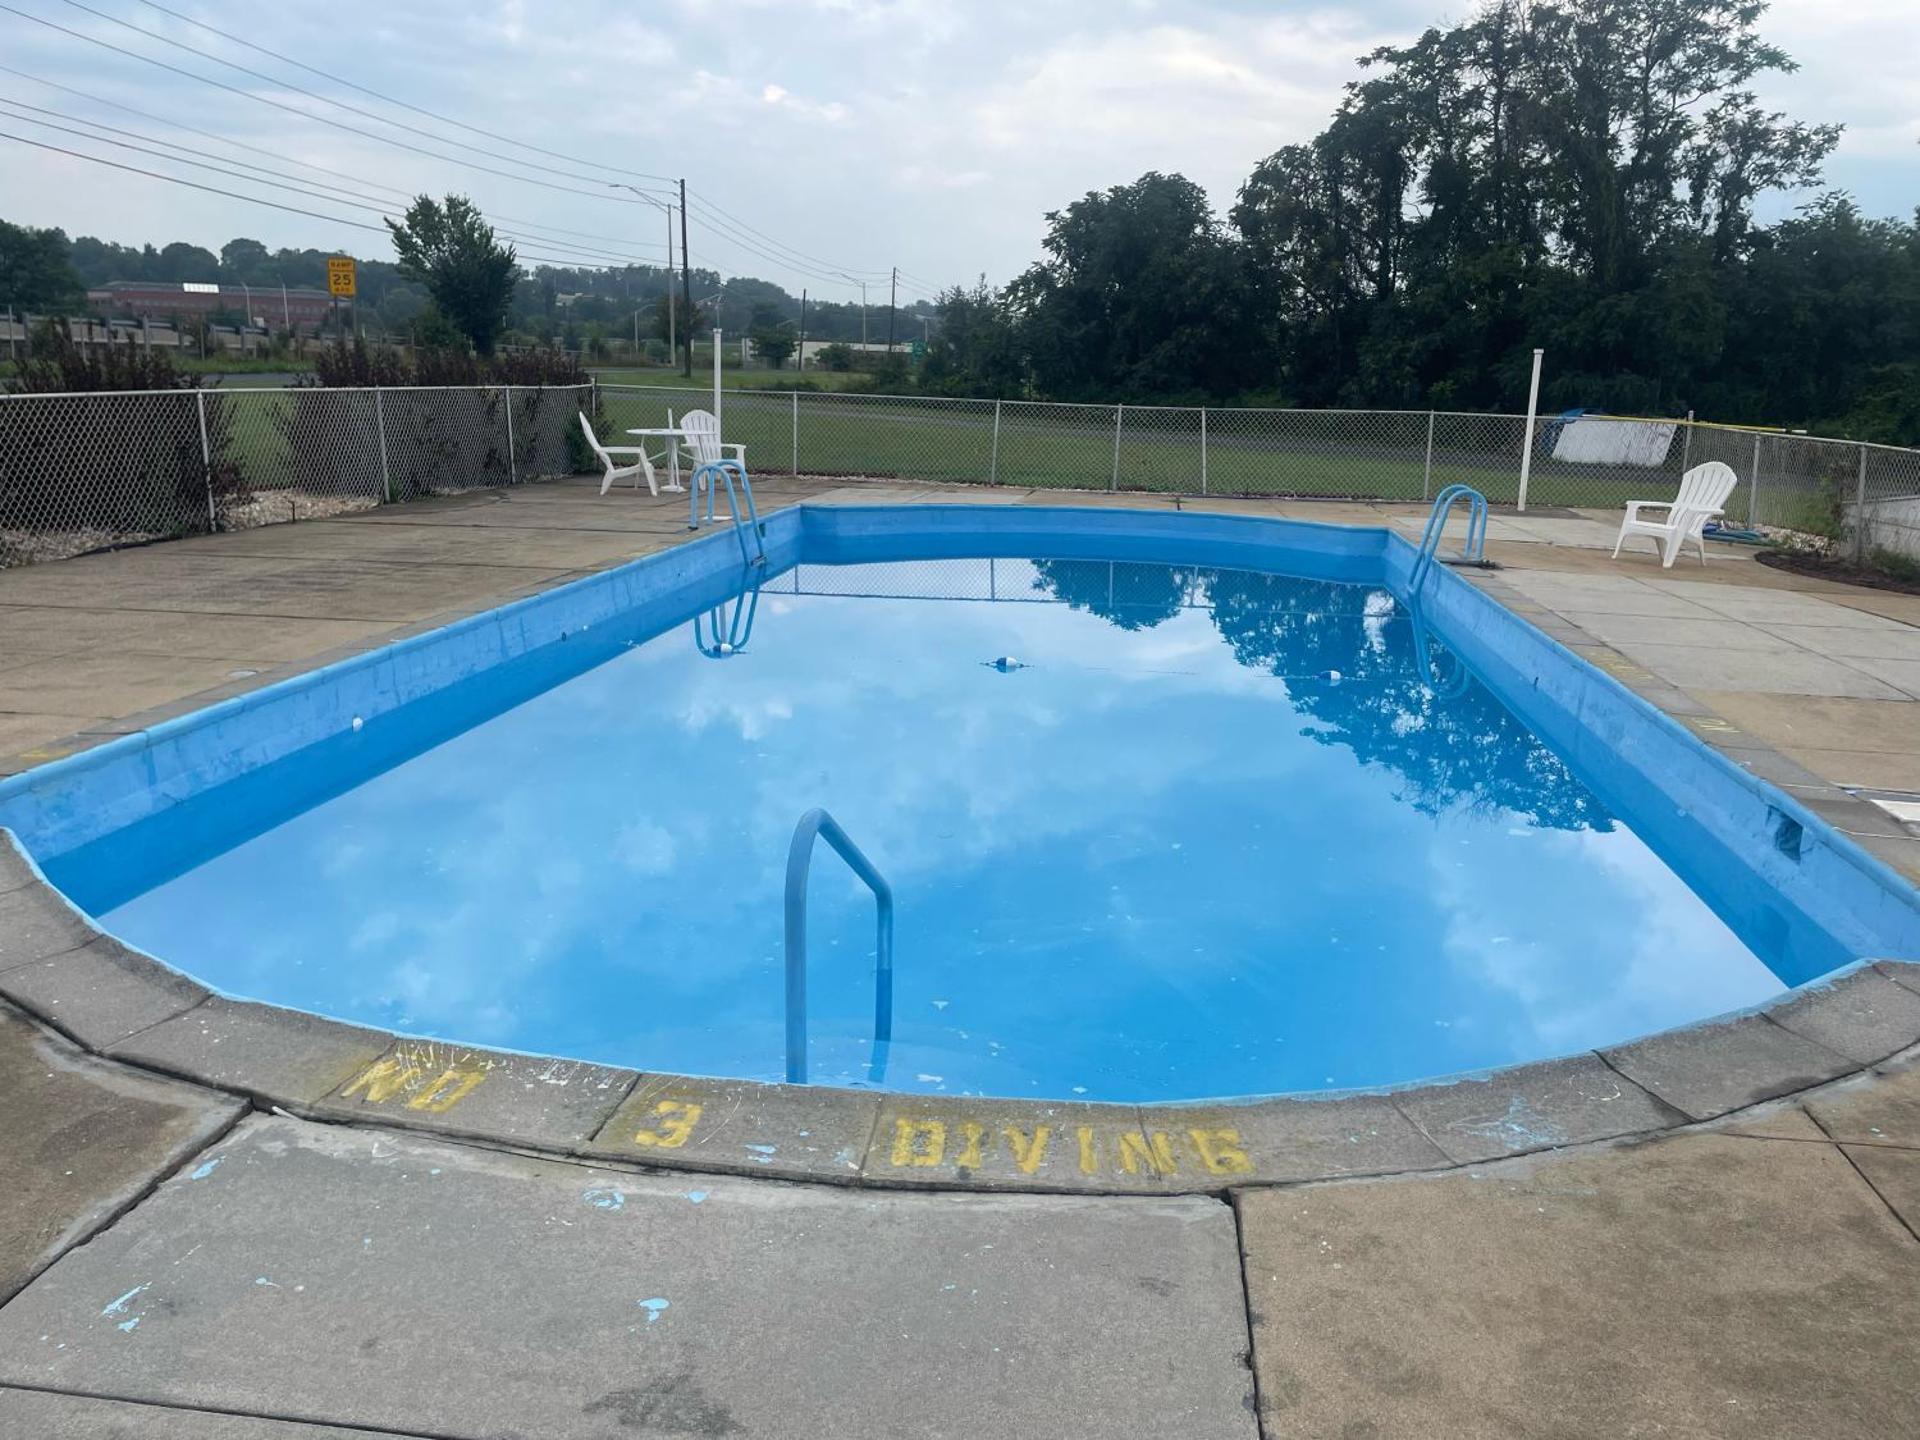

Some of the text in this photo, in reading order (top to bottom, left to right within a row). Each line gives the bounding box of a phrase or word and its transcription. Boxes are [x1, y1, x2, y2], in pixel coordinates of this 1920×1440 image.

[333, 273, 352, 286] 25
[340, 1058, 1256, 1176] NO 3 DIVING
